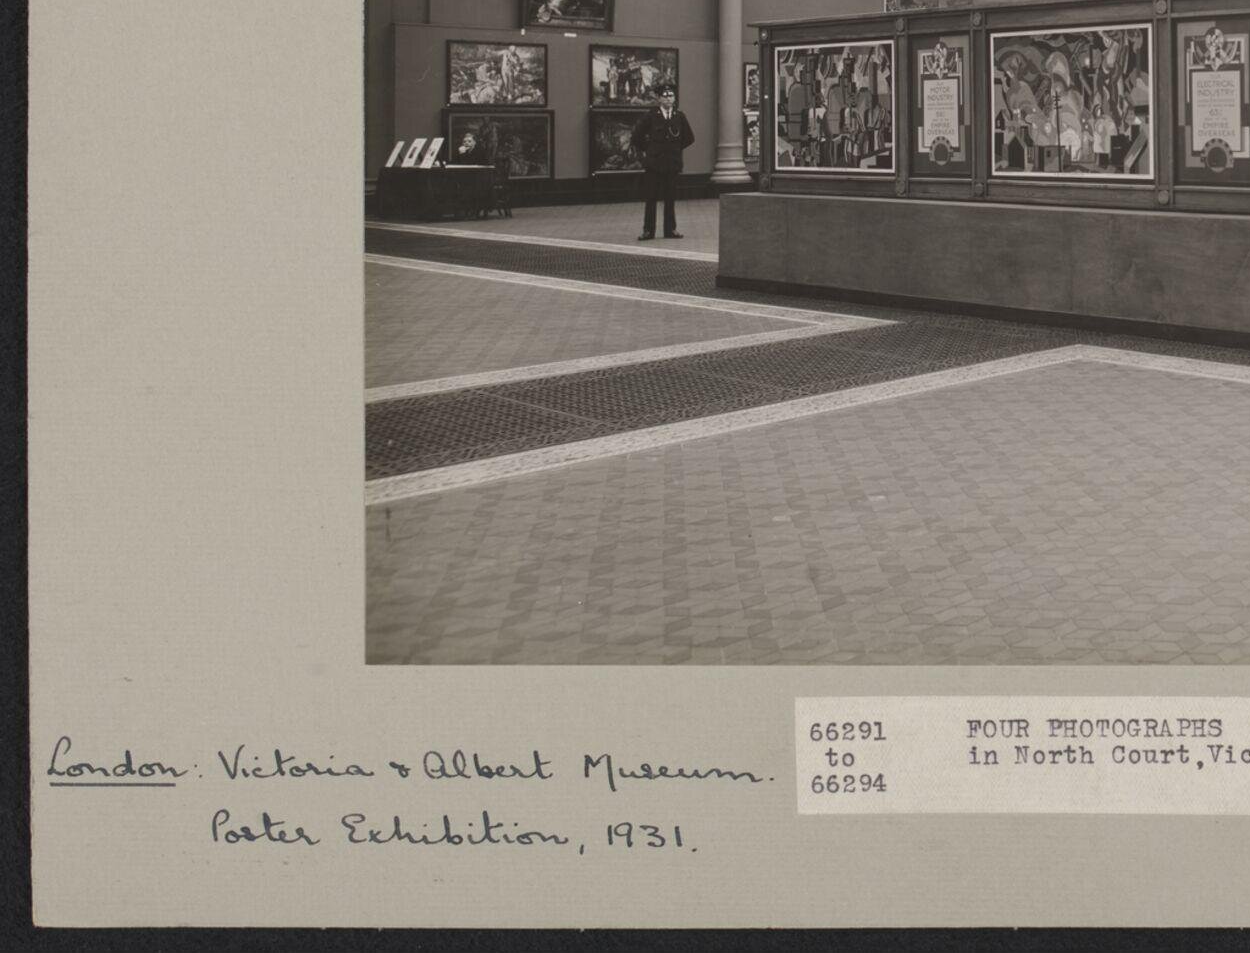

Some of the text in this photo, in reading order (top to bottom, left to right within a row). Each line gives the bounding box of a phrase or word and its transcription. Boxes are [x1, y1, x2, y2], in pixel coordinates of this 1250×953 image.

[809, 721, 887, 742] 66291
[966, 718, 1030, 738] FOUR
[1047, 718, 1223, 738] PHOTOGRAPHS
[217, 744, 375, 780] Victoria
[422, 749, 554, 780] Albert
[824, 747, 855, 767] to
[969, 745, 999, 766] in
[1014, 744, 1095, 765] North
[811, 773, 887, 794] 66294
[211, 808, 321, 846] Poster
[341, 810, 586, 856] Exhibition,
